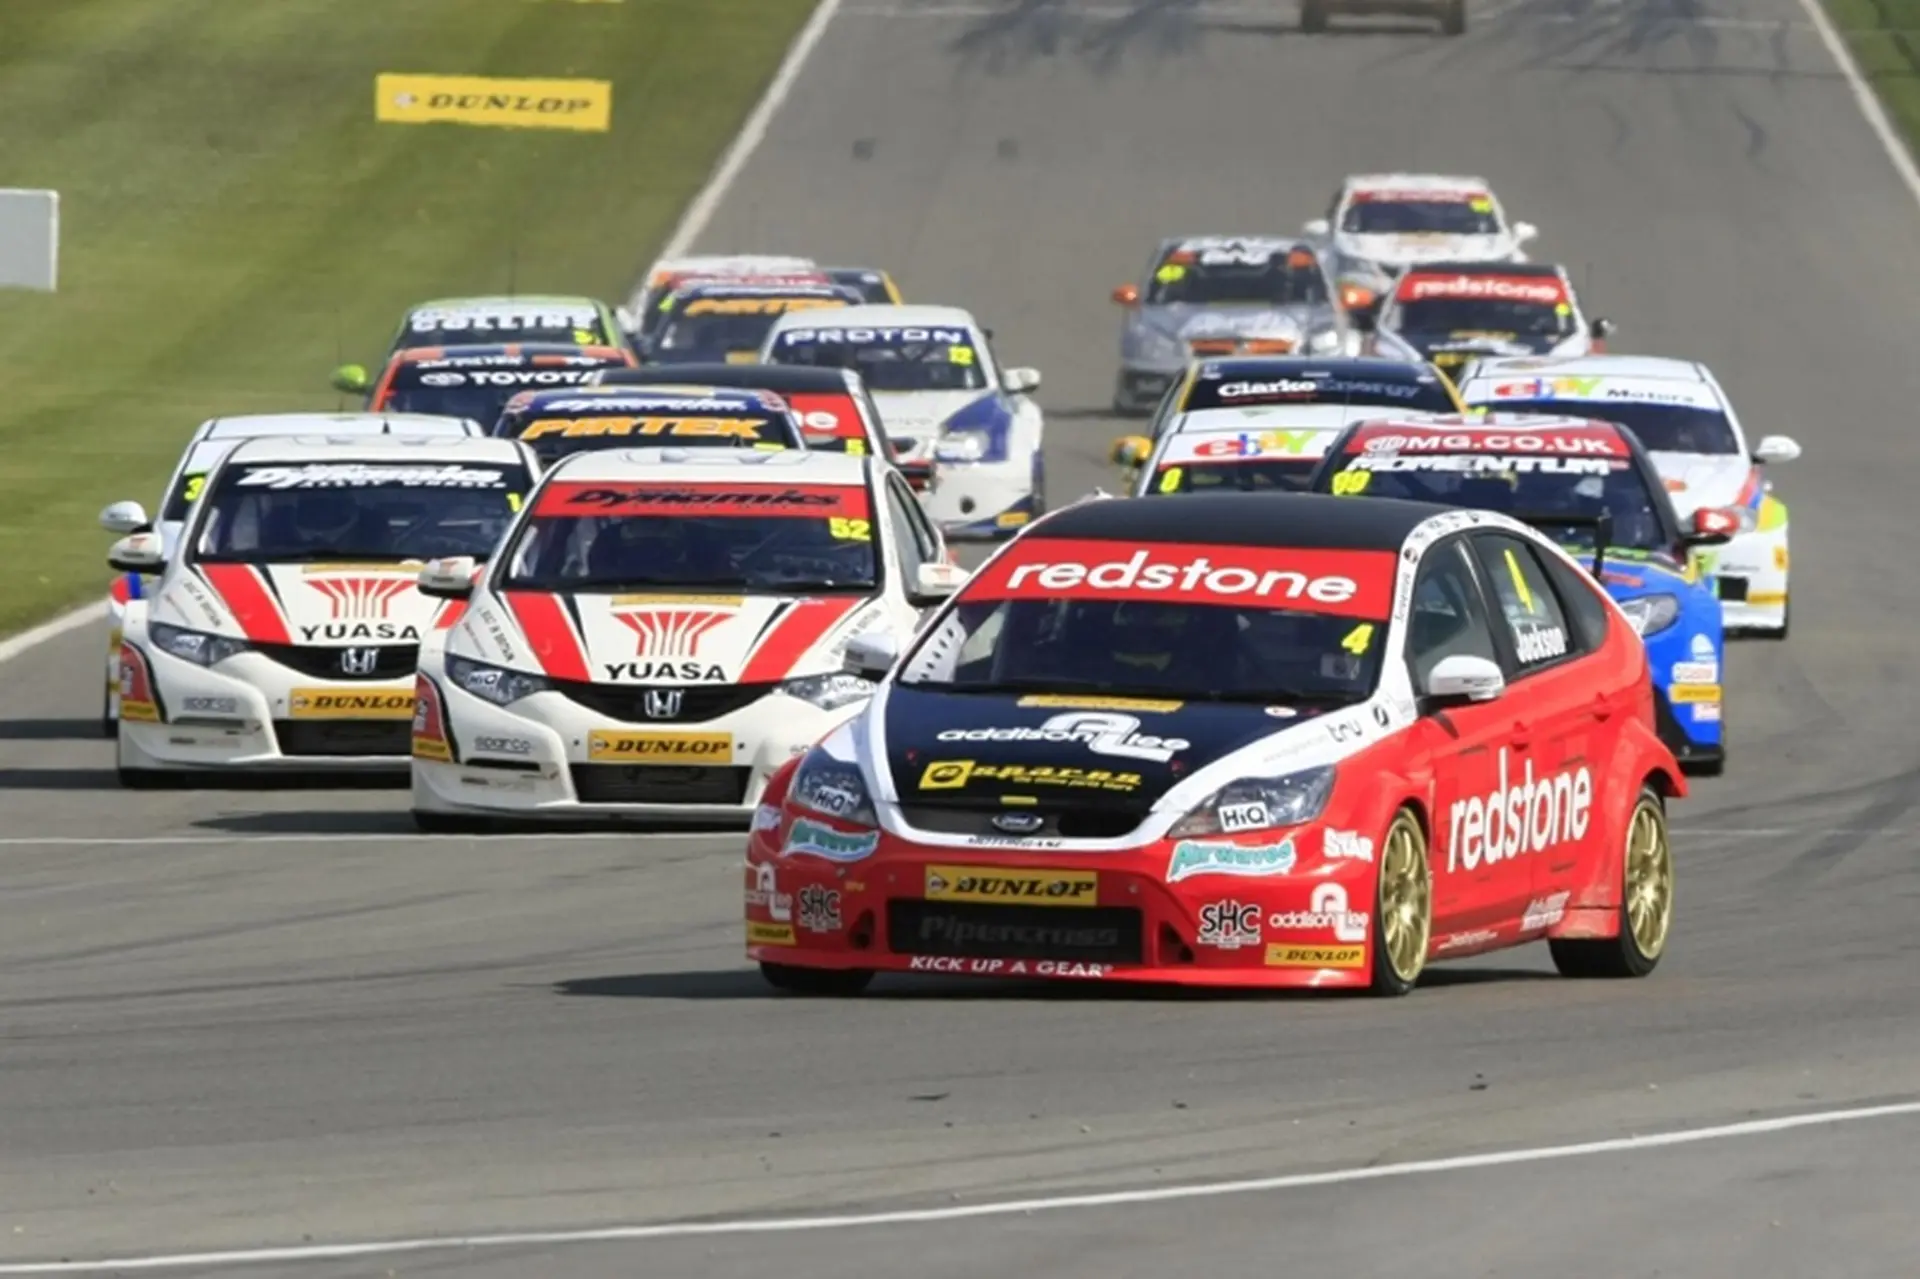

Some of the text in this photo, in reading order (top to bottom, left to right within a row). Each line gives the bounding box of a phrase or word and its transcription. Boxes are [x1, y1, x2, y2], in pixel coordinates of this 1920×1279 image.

[427, 93, 593, 114] DUNLOP
[1413, 276, 1559, 301] redstone
[784, 328, 962, 345] PROTON
[1217, 379, 1317, 397] Clarke
[1318, 379, 1420, 398] Energy
[1402, 434, 1615, 455] MG.CO.UK
[1344, 454, 1611, 476] MOMENTUM
[829, 516, 871, 541] 52
[1006, 550, 1358, 602] redstone
[299, 623, 420, 642] YUASA
[1340, 622, 1374, 655] 4
[604, 662, 728, 681] YUASA
[613, 739, 730, 754] DUNLOP
[936, 728, 1191, 751] addison lee
[815, 790, 846, 812] HiQ
[1447, 746, 1593, 874] redstone
[1223, 806, 1266, 828] HiQ
[1323, 827, 1374, 862] STAR
[954, 877, 1095, 898] DUNLOP
[1201, 902, 1260, 934] SHC
[920, 915, 1119, 947] Pipercross
[909, 955, 965, 970] KICK
[970, 958, 1004, 973] UP
[1009, 960, 1028, 973] A
[1285, 951, 1361, 962] DUNLOP
